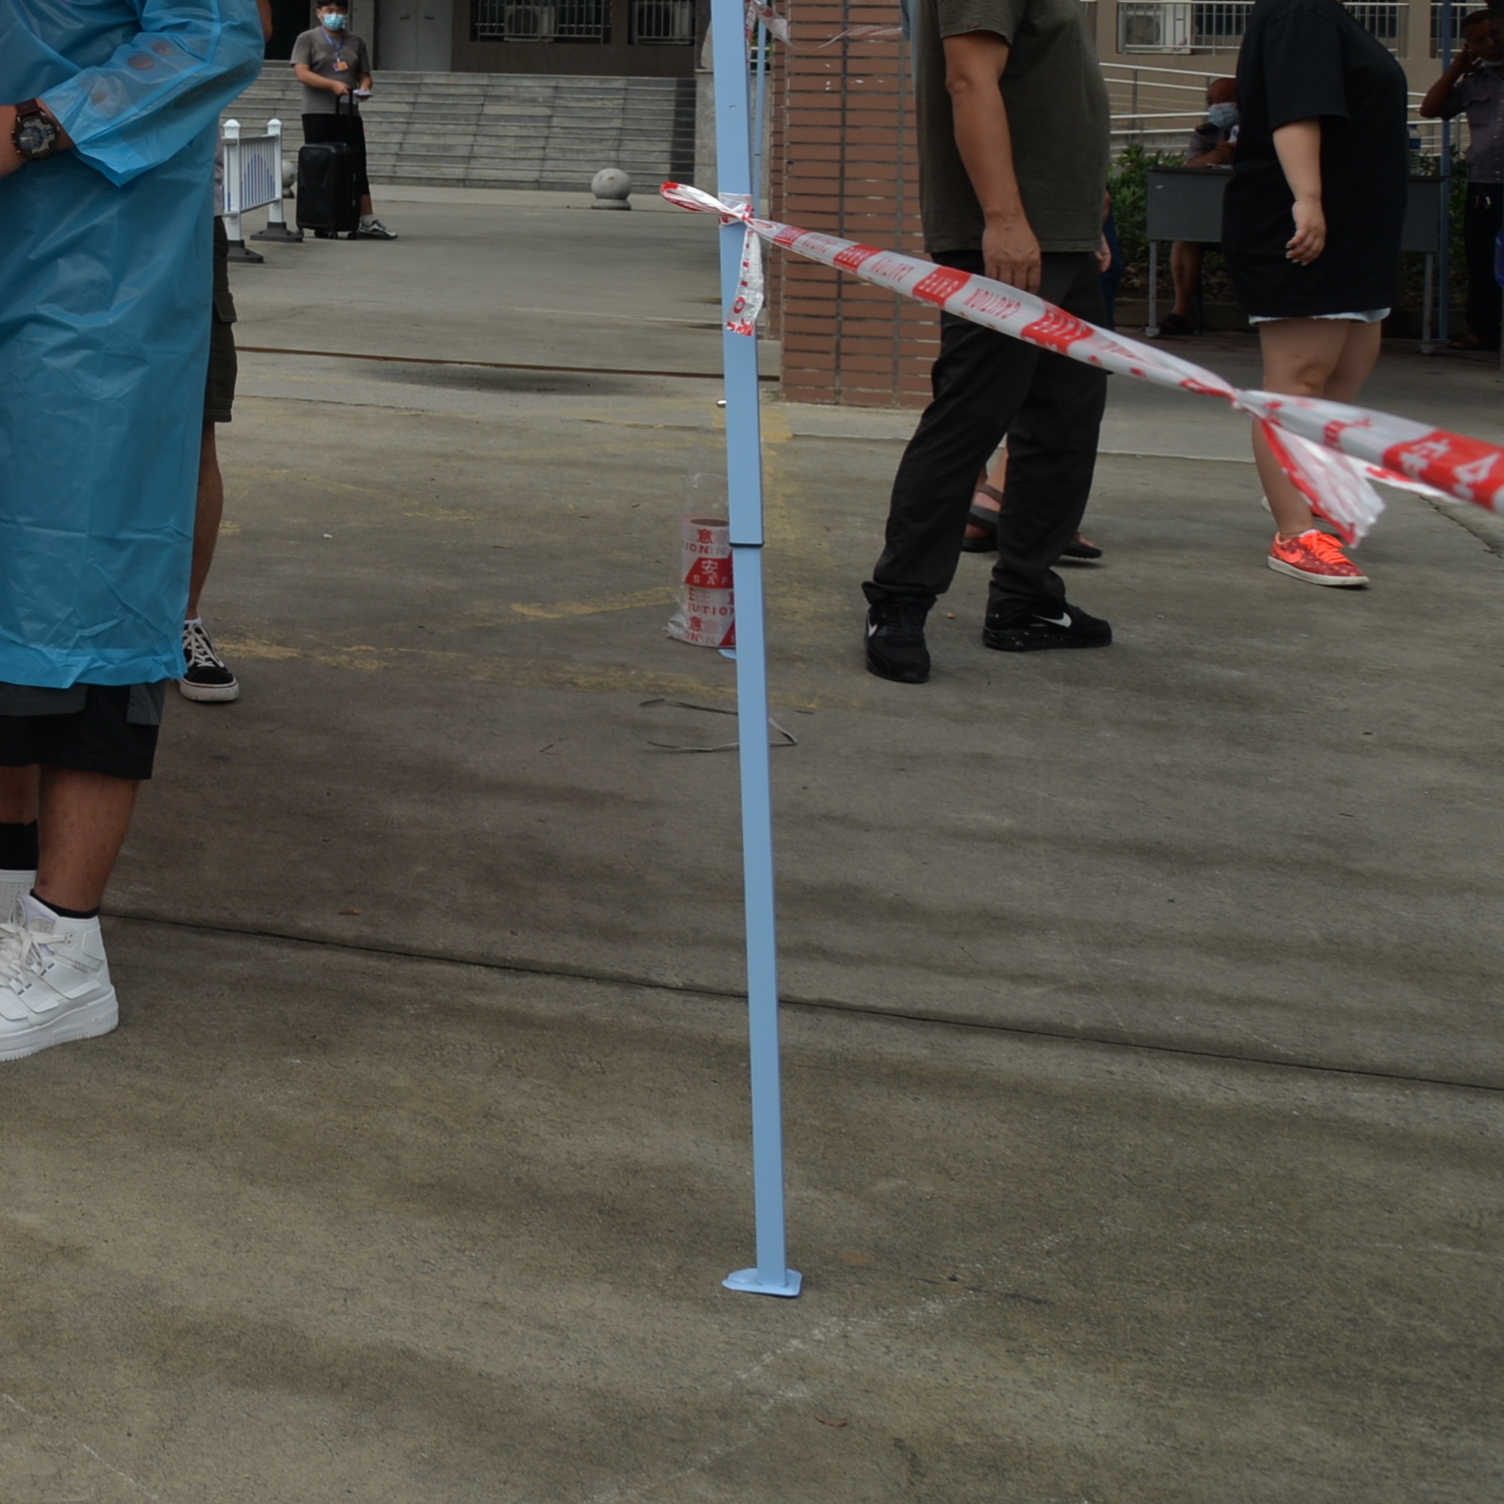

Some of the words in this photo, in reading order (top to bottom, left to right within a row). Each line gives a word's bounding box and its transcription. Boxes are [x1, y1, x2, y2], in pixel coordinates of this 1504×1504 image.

[919, 273, 960, 298] SAFE
[964, 288, 1021, 320] CAUTION
[693, 575, 729, 586] SAF
